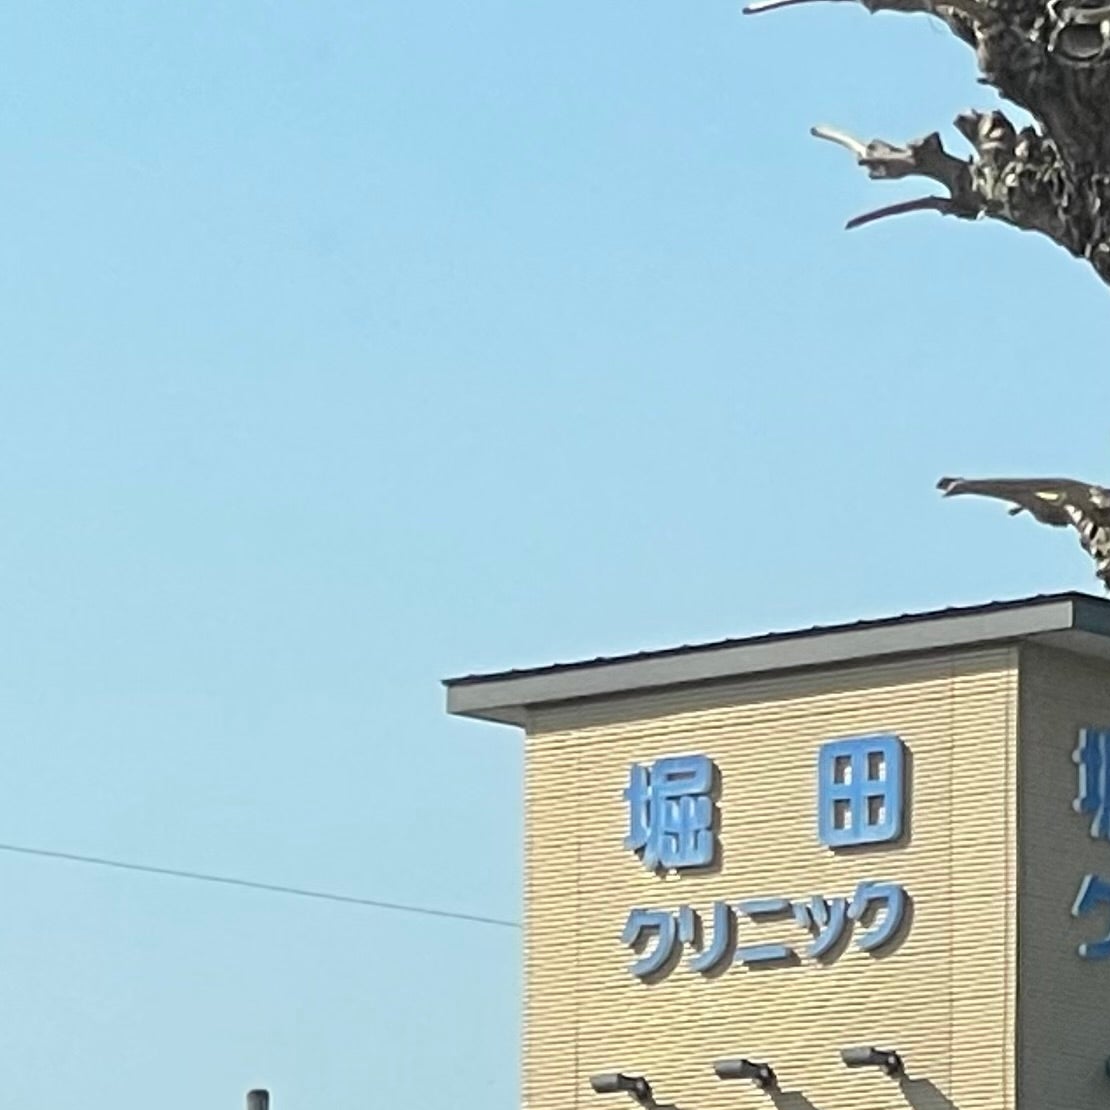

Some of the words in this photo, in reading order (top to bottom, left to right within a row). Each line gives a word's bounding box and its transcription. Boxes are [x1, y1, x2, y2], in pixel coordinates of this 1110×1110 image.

[622, 732, 910, 870] 堀田
[620, 879, 910, 980] クリニック
